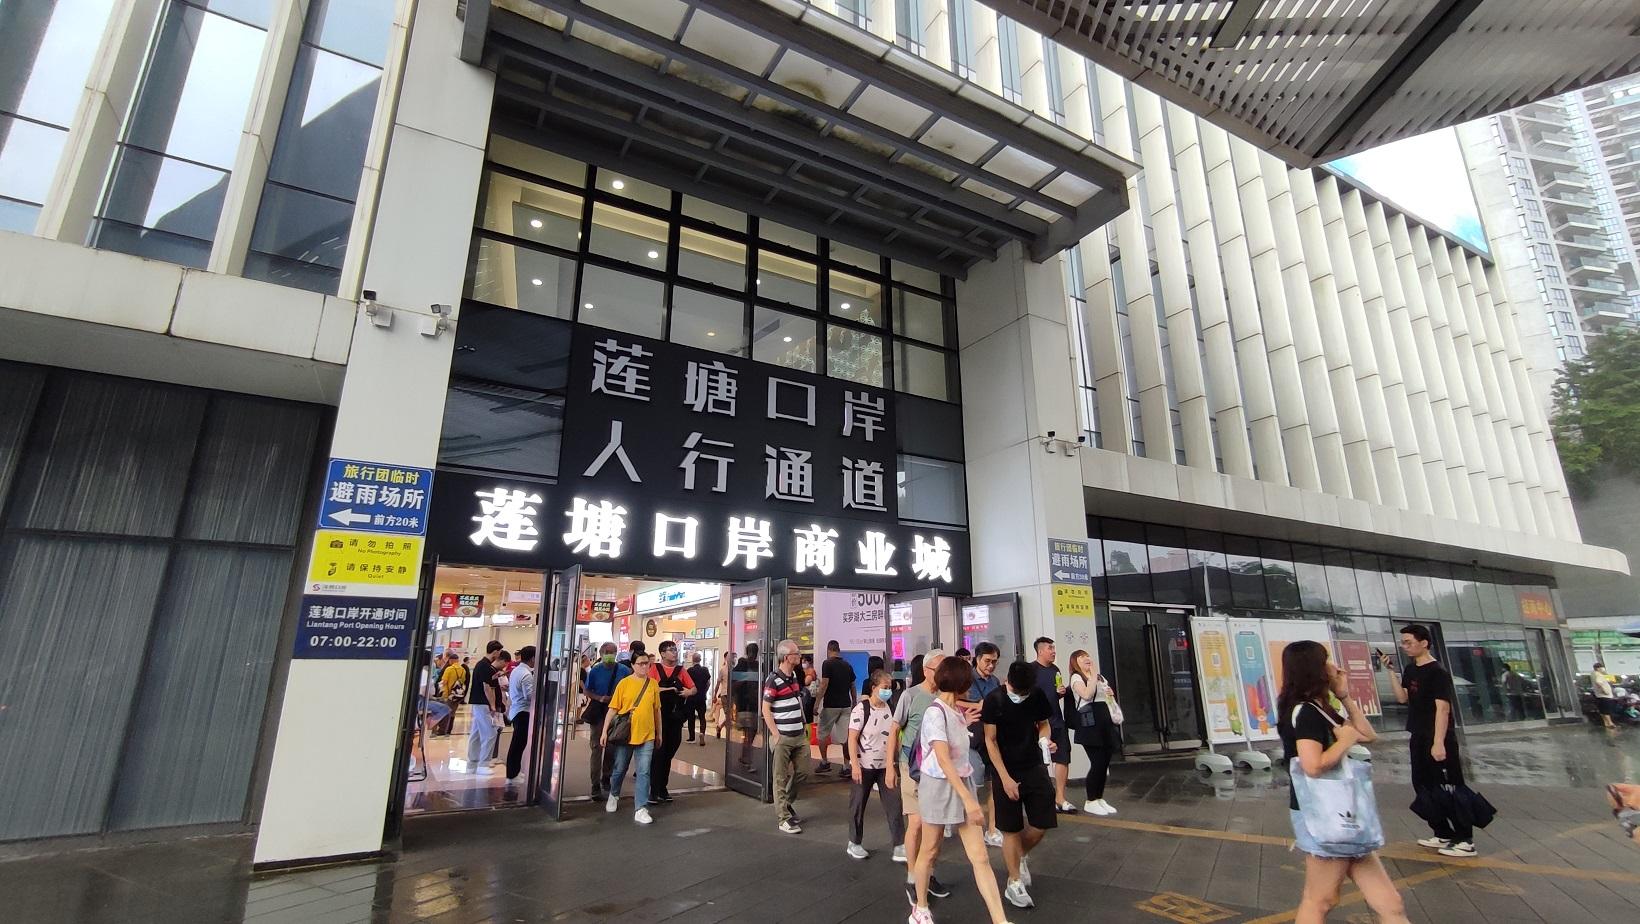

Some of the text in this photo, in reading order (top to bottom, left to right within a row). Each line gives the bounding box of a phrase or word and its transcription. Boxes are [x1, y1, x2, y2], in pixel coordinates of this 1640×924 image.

[589, 337, 886, 443] 莲塘口岸
[343, 464, 420, 486] 旅行团临时
[583, 420, 888, 513] 人行通道
[329, 481, 425, 510] 避雨场所
[373, 514, 419, 529] 前方20米
[469, 487, 953, 584] 莲塘口岸商业城
[349, 538, 412, 551] 请勿拍照
[346, 562, 407, 575] 请保持安静
[1051, 552, 1088, 570] 避雨场所
[308, 605, 408, 622] 莲塘口岸开通时间
[306, 620, 338, 630] Liantang
[339, 621, 355, 630] Port
[355, 622, 384, 631] Opening
[310, 635, 398, 648] 07:00-22:00
